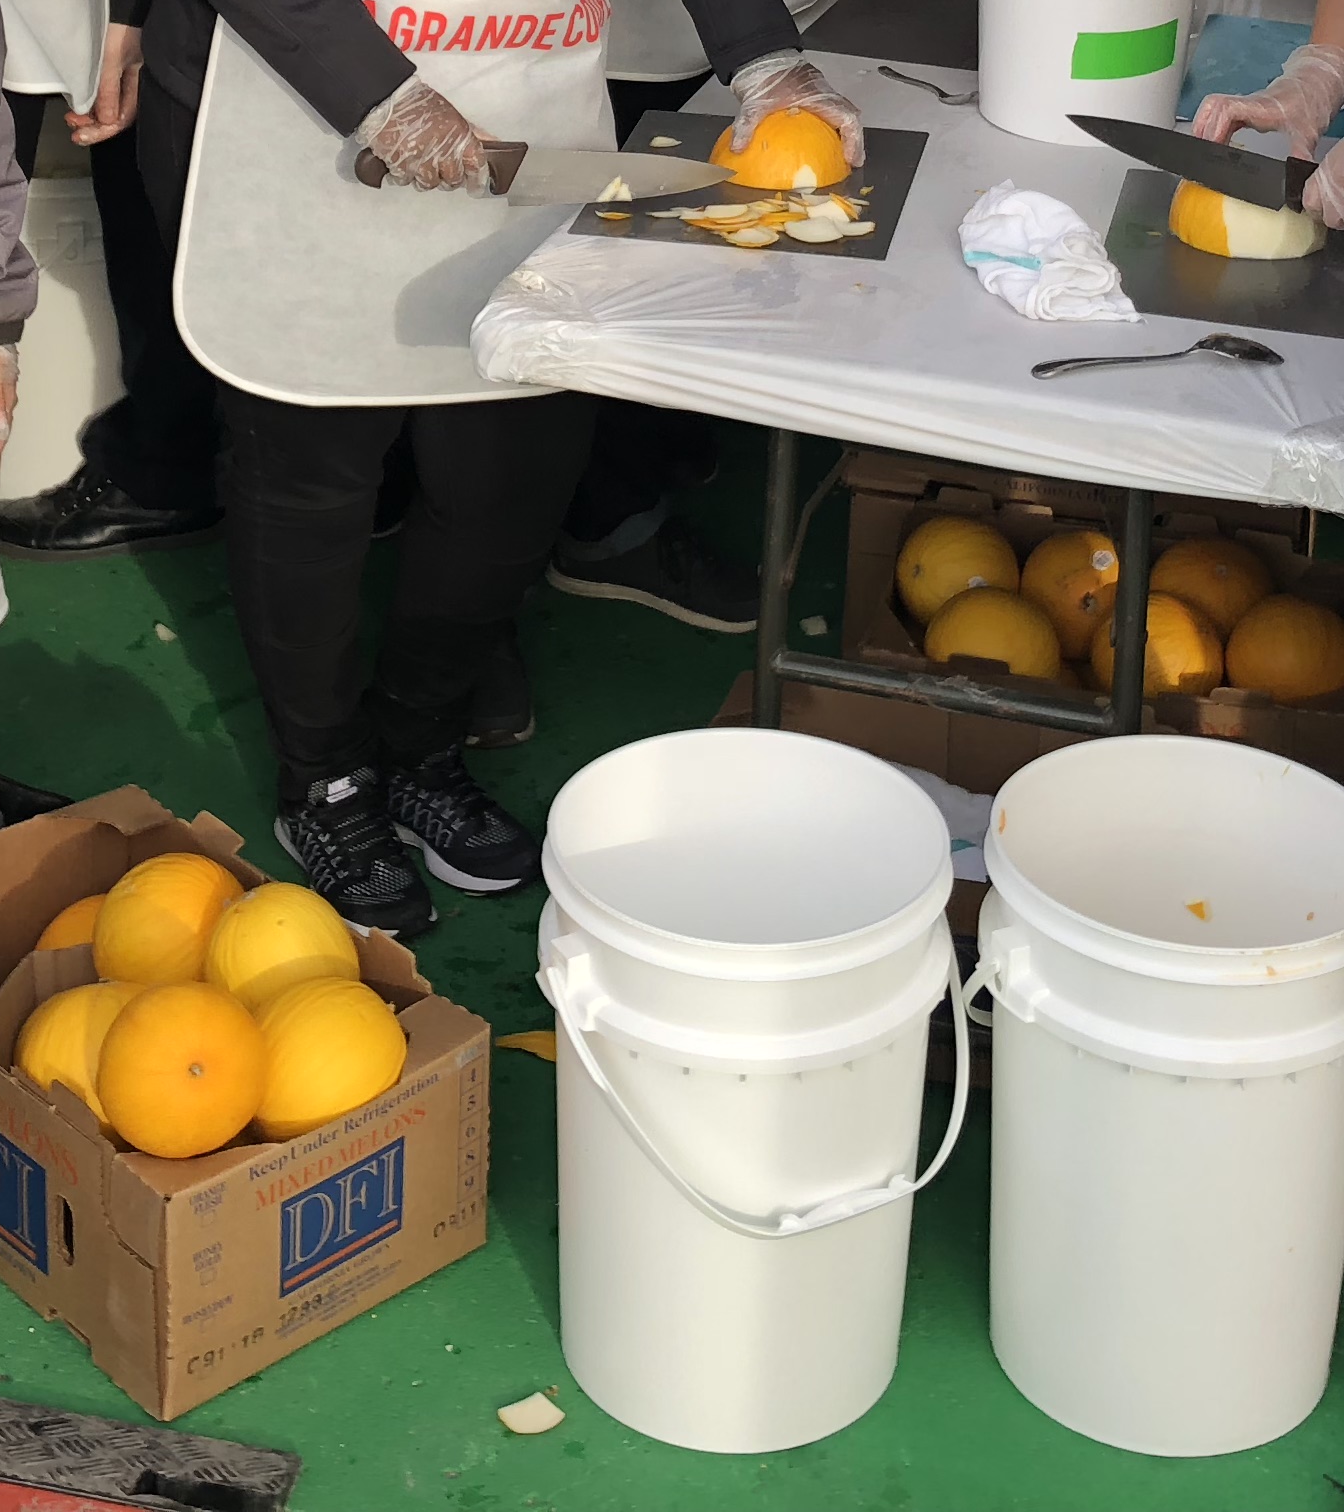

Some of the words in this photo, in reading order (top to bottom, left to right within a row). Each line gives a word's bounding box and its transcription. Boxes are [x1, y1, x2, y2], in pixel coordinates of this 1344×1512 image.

[387, 5, 565, 53] GRANDE
[249, 1153, 292, 1181] Keep
[290, 1128, 340, 1161] Under
[343, 1070, 441, 1134] Refrigeration
[256, 1155, 337, 1212] MIXED
[339, 1097, 428, 1165] MELONS
[284, 1145, 402, 1272] DFI
